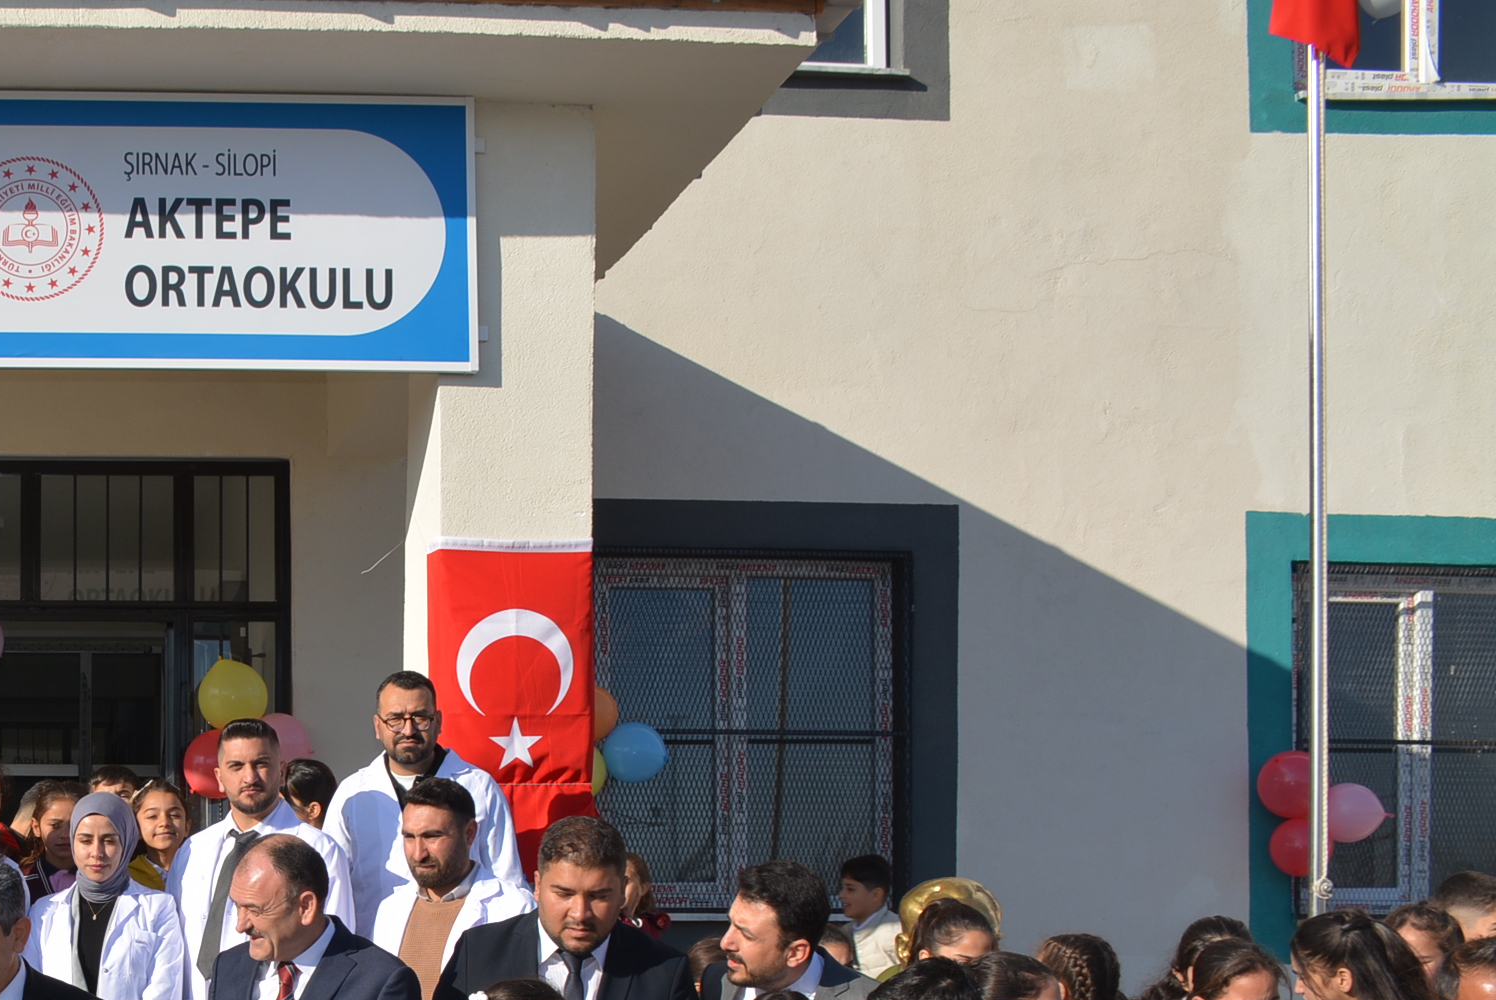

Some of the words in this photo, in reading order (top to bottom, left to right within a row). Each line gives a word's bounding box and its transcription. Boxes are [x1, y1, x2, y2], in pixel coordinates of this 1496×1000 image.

[123, 151, 198, 181] ŞIRNAK
[215, 148, 278, 177] SİLOPİ
[55, 193, 77, 226] EĞİTİM
[123, 197, 292, 241] AKTEPE
[41, 228, 78, 273] BAKANLIĞI
[123, 264, 395, 312] ORTAOKULU
